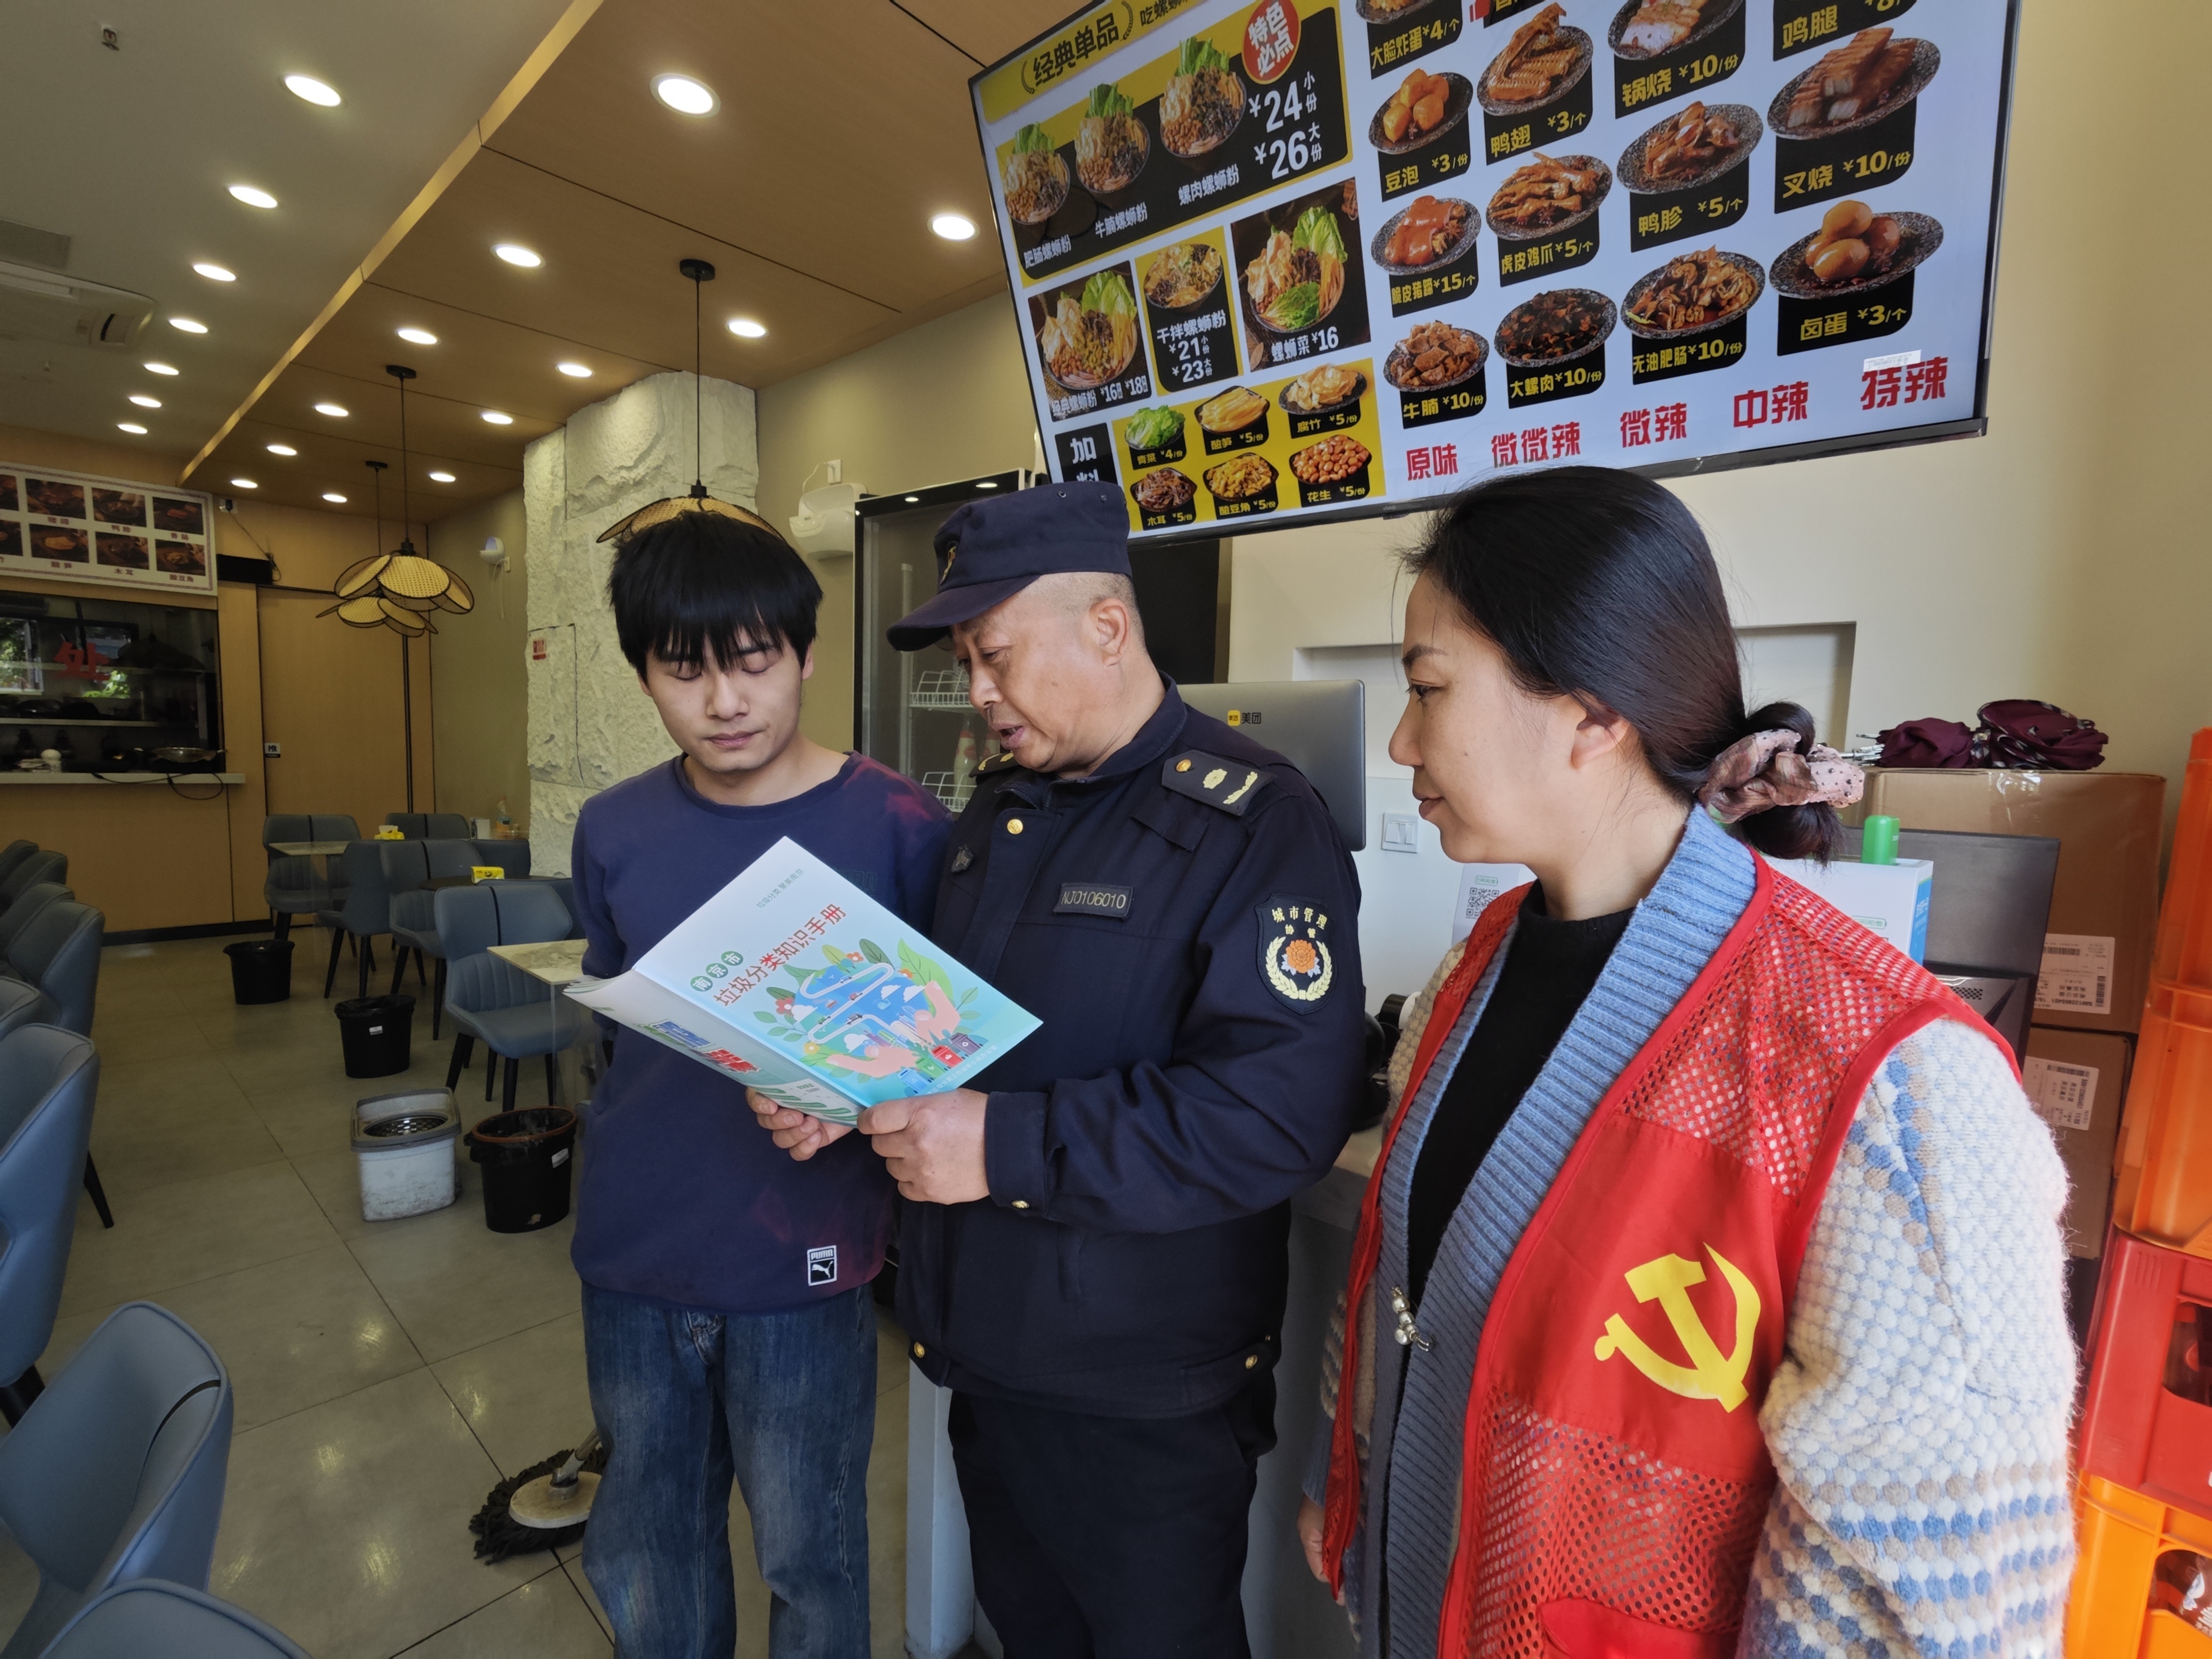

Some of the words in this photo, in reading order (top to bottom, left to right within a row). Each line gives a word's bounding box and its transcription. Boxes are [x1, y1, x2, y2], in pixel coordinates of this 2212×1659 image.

[1249, 3, 1289, 50] 特色
[1782, 5, 1838, 49] 鸡腿
[1033, 13, 1120, 85] 经典单品
[1257, 25, 1294, 78] 必点
[1371, 25, 1423, 70] 大脸炸蛋
[1249, 80, 1302, 133] ¥24
[1303, 71, 1317, 113] 小份
[1622, 68, 1673, 108] 锅烧
[1253, 131, 1309, 179] ¥26
[1308, 122, 1322, 161] 大份
[1491, 124, 1532, 158] 鸭翅
[1178, 164, 1239, 206] 螺肉螺蛳粉
[1385, 165, 1419, 194] 豆泡
[1783, 164, 1833, 199] 叉烧
[1095, 201, 1148, 238] 牛腩螺蛳粉
[1638, 205, 1683, 237] 鸭胗
[1501, 242, 1554, 275] 虎皮鸡爪
[1391, 277, 1433, 305] 脆皮猪蹄
[1157, 309, 1226, 345] 干拌螺蛳粉
[1800, 311, 1848, 341] 卤蛋
[1169, 337, 1201, 361] ¥21
[1201, 335, 1210, 353] 小份
[1271, 336, 1310, 362] 螺蛳菜
[1312, 326, 1339, 352] ¥16
[1633, 345, 1688, 376] 无油肥肠
[1171, 360, 1204, 383] ¥23
[1204, 358, 1213, 377] 大份
[1510, 376, 1554, 399] 大螺肉
[1403, 397, 1439, 420] 牛腩
[1733, 381, 1809, 428] 中辣
[1297, 419, 1321, 433] 腐竹
[1620, 402, 1687, 448] 微辣
[1210, 437, 1232, 450] 酸笋
[1491, 421, 1581, 468] 微微辣
[1137, 455, 1156, 466] 青菜
[1406, 443, 1459, 481] 原味
[1218, 503, 1251, 516] 酸豆角
[1307, 490, 1332, 503] 花生
[1147, 515, 1166, 526] 木耳
[1241, 712, 1262, 725] 美团
[1061, 890, 1127, 909] NJ0106010
[1271, 905, 1327, 930] 城市管理
[713, 903, 847, 1006] 垃圾分类知识手册
[692, 952, 741, 992] 南京市
[811, 1249, 833, 1260] PUMA
